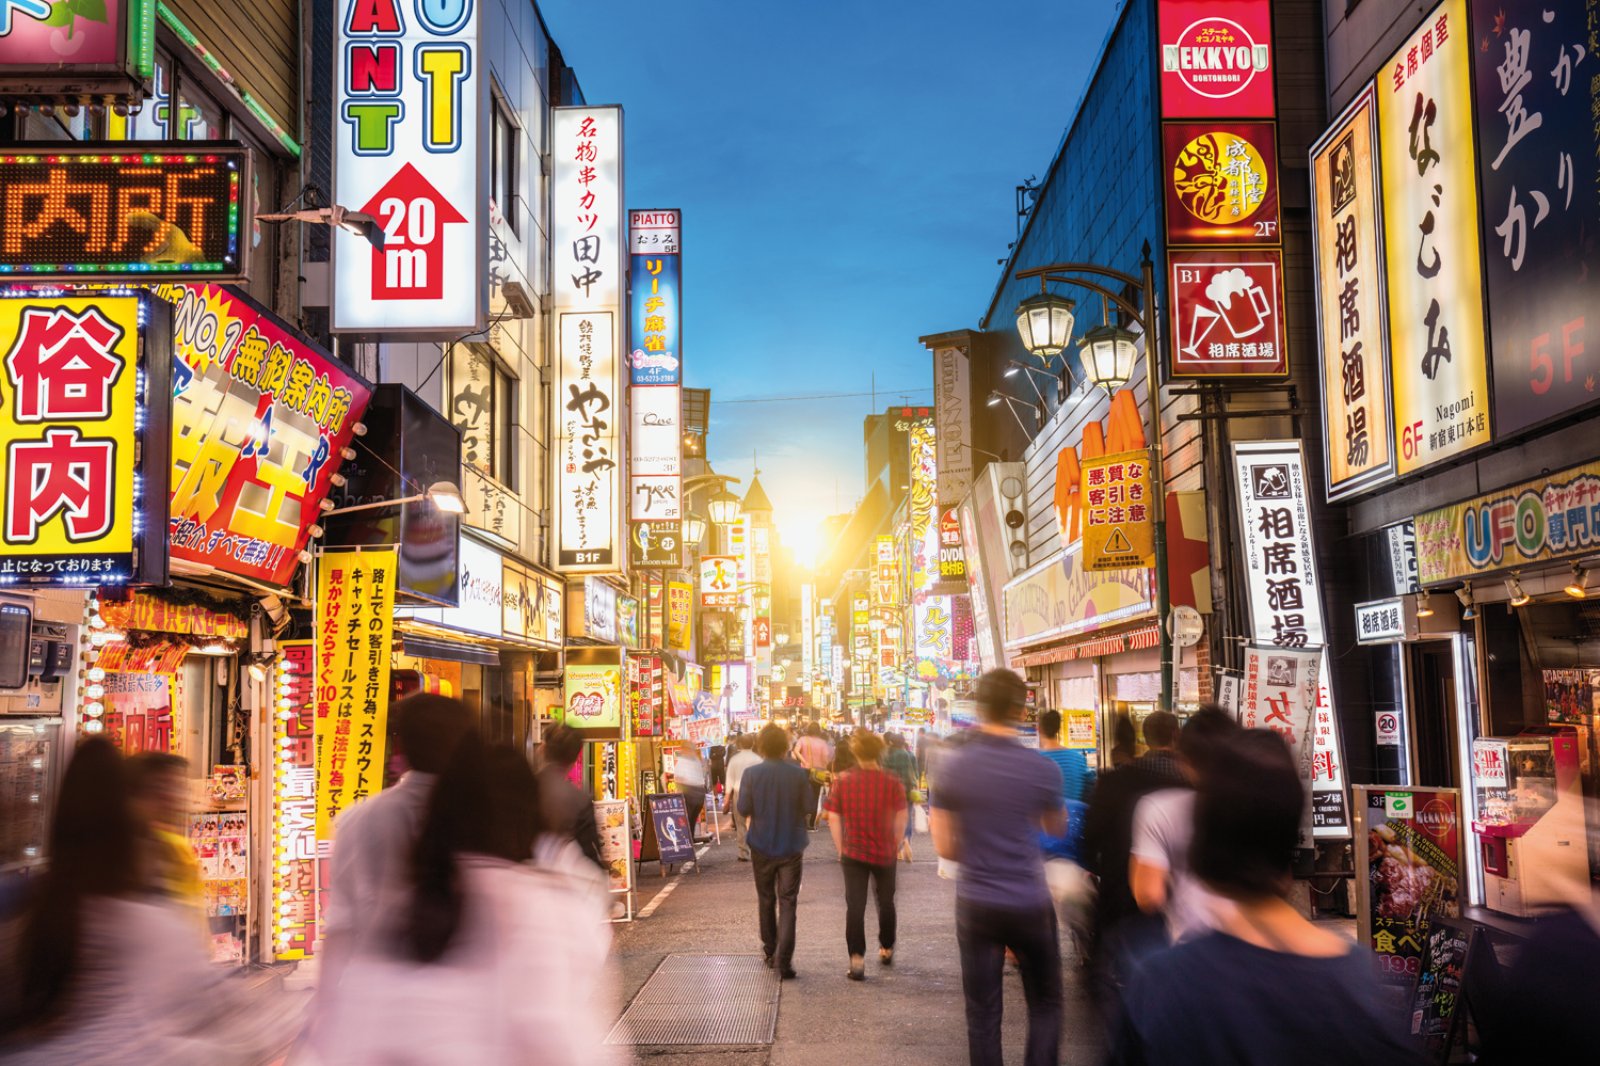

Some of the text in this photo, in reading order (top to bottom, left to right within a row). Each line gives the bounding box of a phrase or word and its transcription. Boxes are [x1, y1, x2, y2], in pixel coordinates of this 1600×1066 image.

[1163, 44, 1268, 72] NEKKYOU
[1393, 15, 1449, 93] 全席個室
[1542, 10, 1585, 210] かり
[1492, 27, 1550, 272] 豊か
[576, 116, 598, 232] 名物串カツ
[379, 197, 436, 245] 20
[633, 213, 675, 225] PIATTO
[1254, 221, 1277, 237] 2F
[1408, 92, 1451, 380] なごみ
[571, 235, 603, 298] 田中
[665, 245, 677, 253] 5F
[386, 249, 428, 288] m
[1180, 270, 1202, 283] B1
[644, 260, 666, 351] リーチ麻雀
[1208, 343, 1275, 358] 相席酒場
[1335, 214, 1369, 467] 相席酒場
[1530, 317, 1585, 395] 5F
[4, 308, 125, 423] 俗
[231, 327, 354, 435] 無料案内所
[1436, 391, 1475, 420] Nagomi
[1402, 420, 1424, 461] 6F
[1429, 418, 1485, 451] 新宿東口本店
[3, 427, 117, 544] 内
[1089, 463, 1143, 485] 悪質な
[1089, 485, 1143, 505] 客引き
[1545, 481, 1600, 512] キャッチャ
[1089, 506, 1146, 525] に注意
[1465, 490, 1546, 568] UFO
[576, 553, 600, 563] B1F
[1258, 506, 1308, 648] 相席酒場
[1362, 610, 1398, 634] 相席酒場
[316, 569, 343, 719] 見かけたらすぐ110番
[1380, 717, 1394, 731] 20
[1372, 796, 1386, 806] 3F
[1375, 917, 1415, 928] ステーキ
[1373, 929, 1427, 953] 食べ
